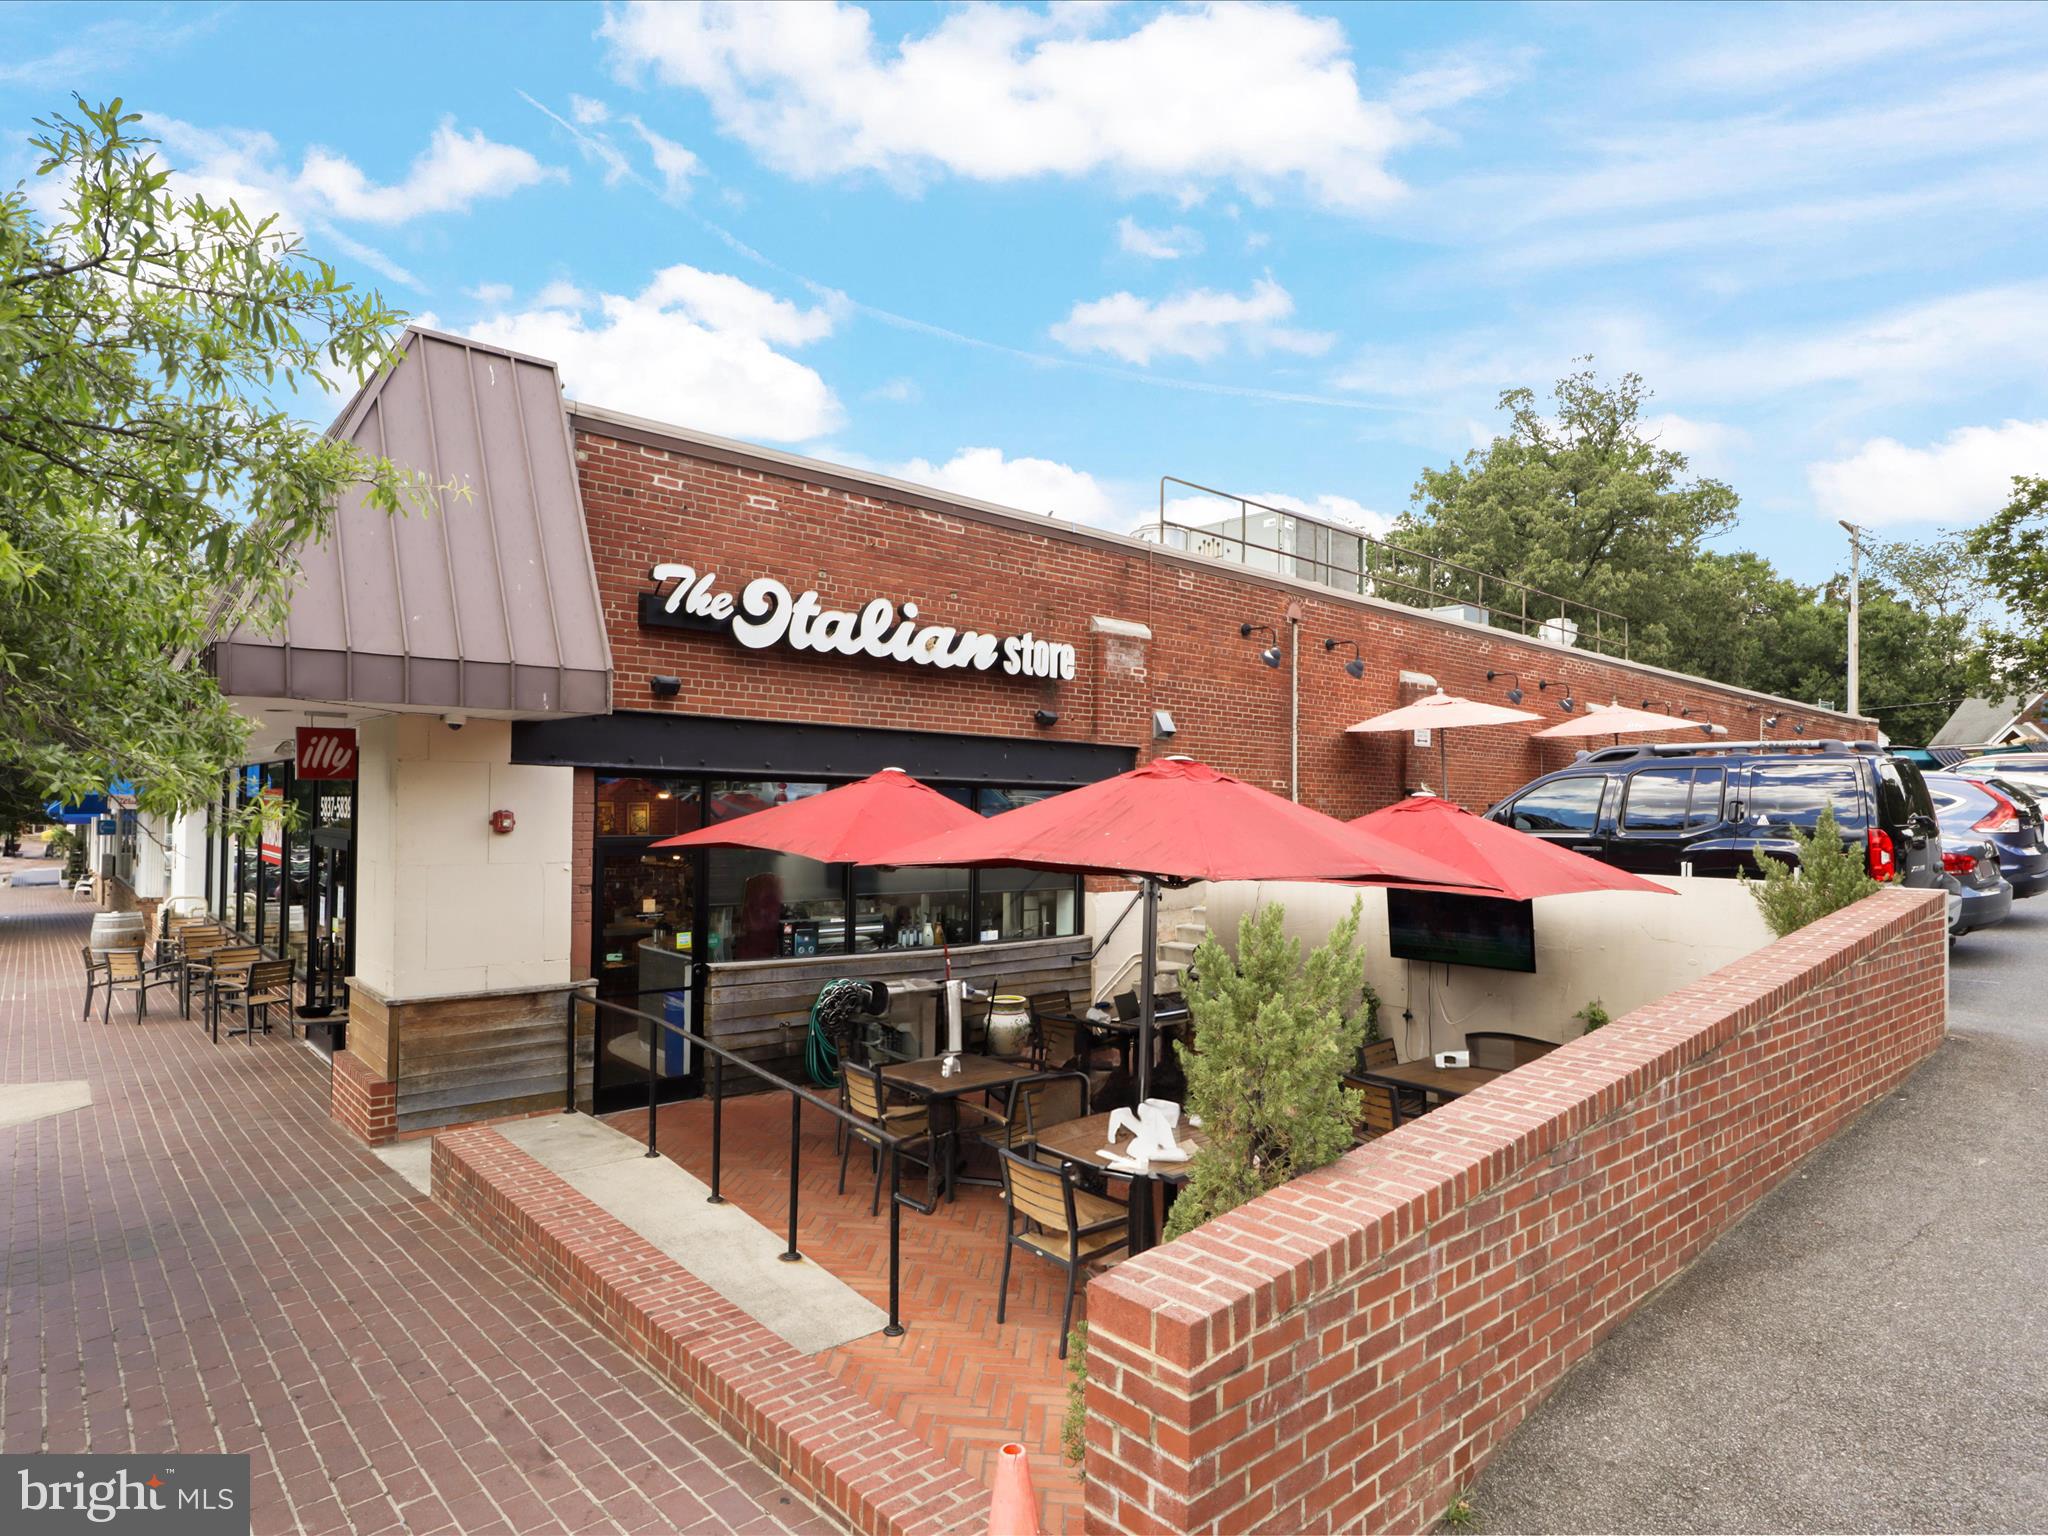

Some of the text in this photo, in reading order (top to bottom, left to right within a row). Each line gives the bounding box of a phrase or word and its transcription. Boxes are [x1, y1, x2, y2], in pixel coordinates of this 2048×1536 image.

[653, 563, 1076, 680] The Italian store
[302, 736, 352, 776] illy
